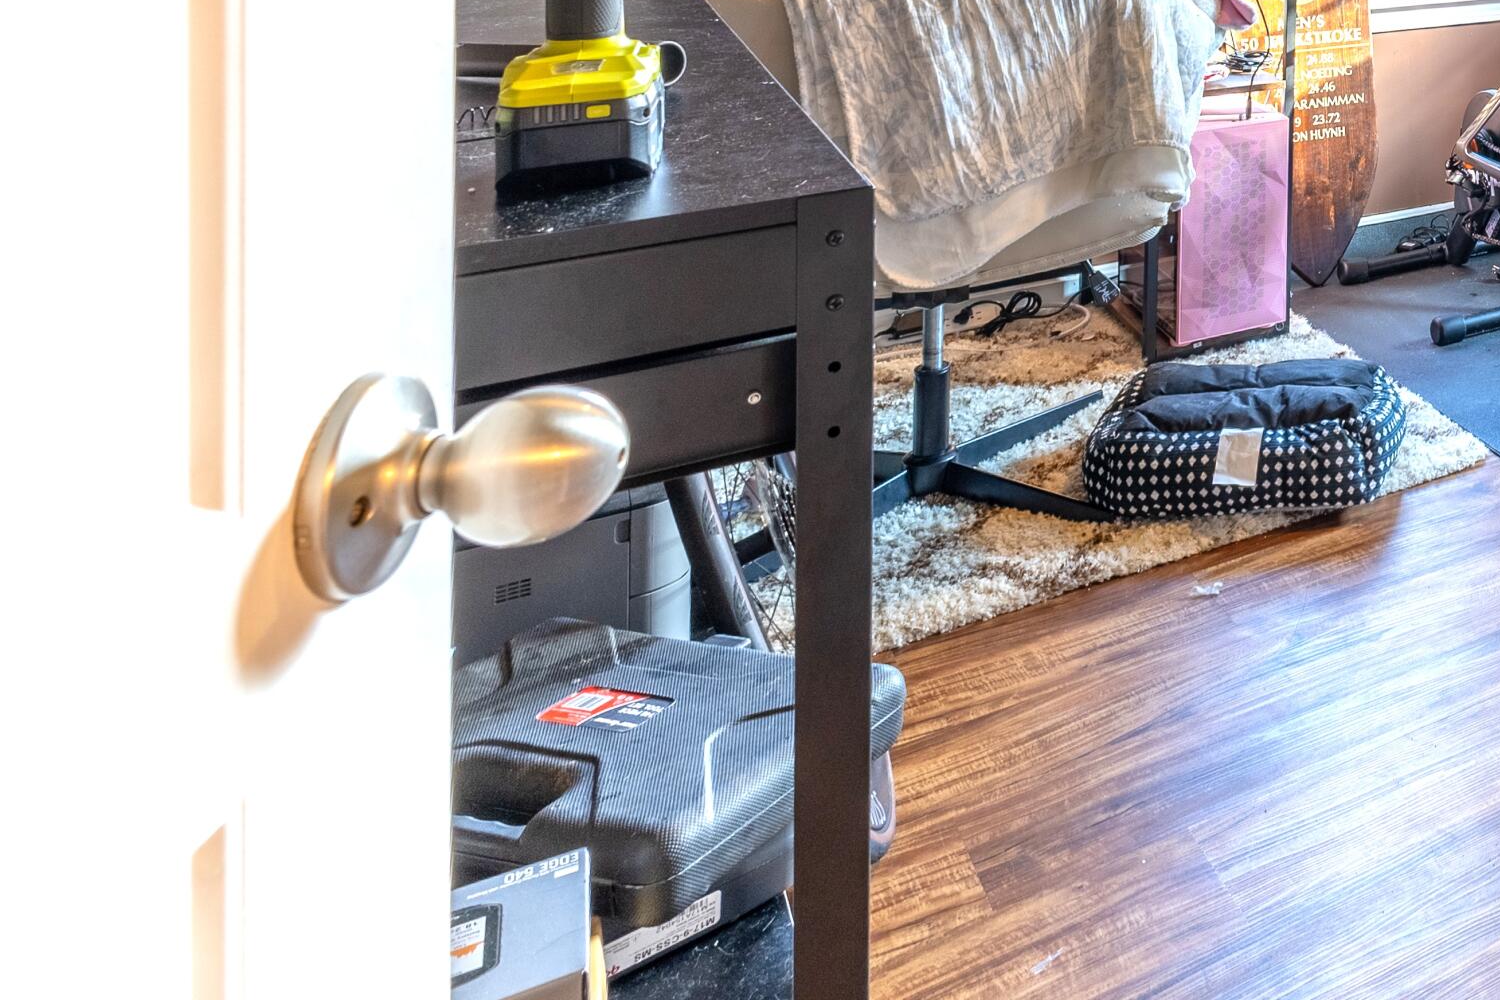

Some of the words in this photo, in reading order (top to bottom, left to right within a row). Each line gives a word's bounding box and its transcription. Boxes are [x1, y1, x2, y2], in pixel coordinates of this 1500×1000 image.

[1308, 81, 1336, 95] 24.46
[1294, 93, 1365, 110] ARANIMMAN
[1312, 112, 1341, 126] 23.72
[1293, 131, 1308, 142] ON
[1309, 126, 1346, 141] HUYNH
[539, 851, 579, 873] EDGE
